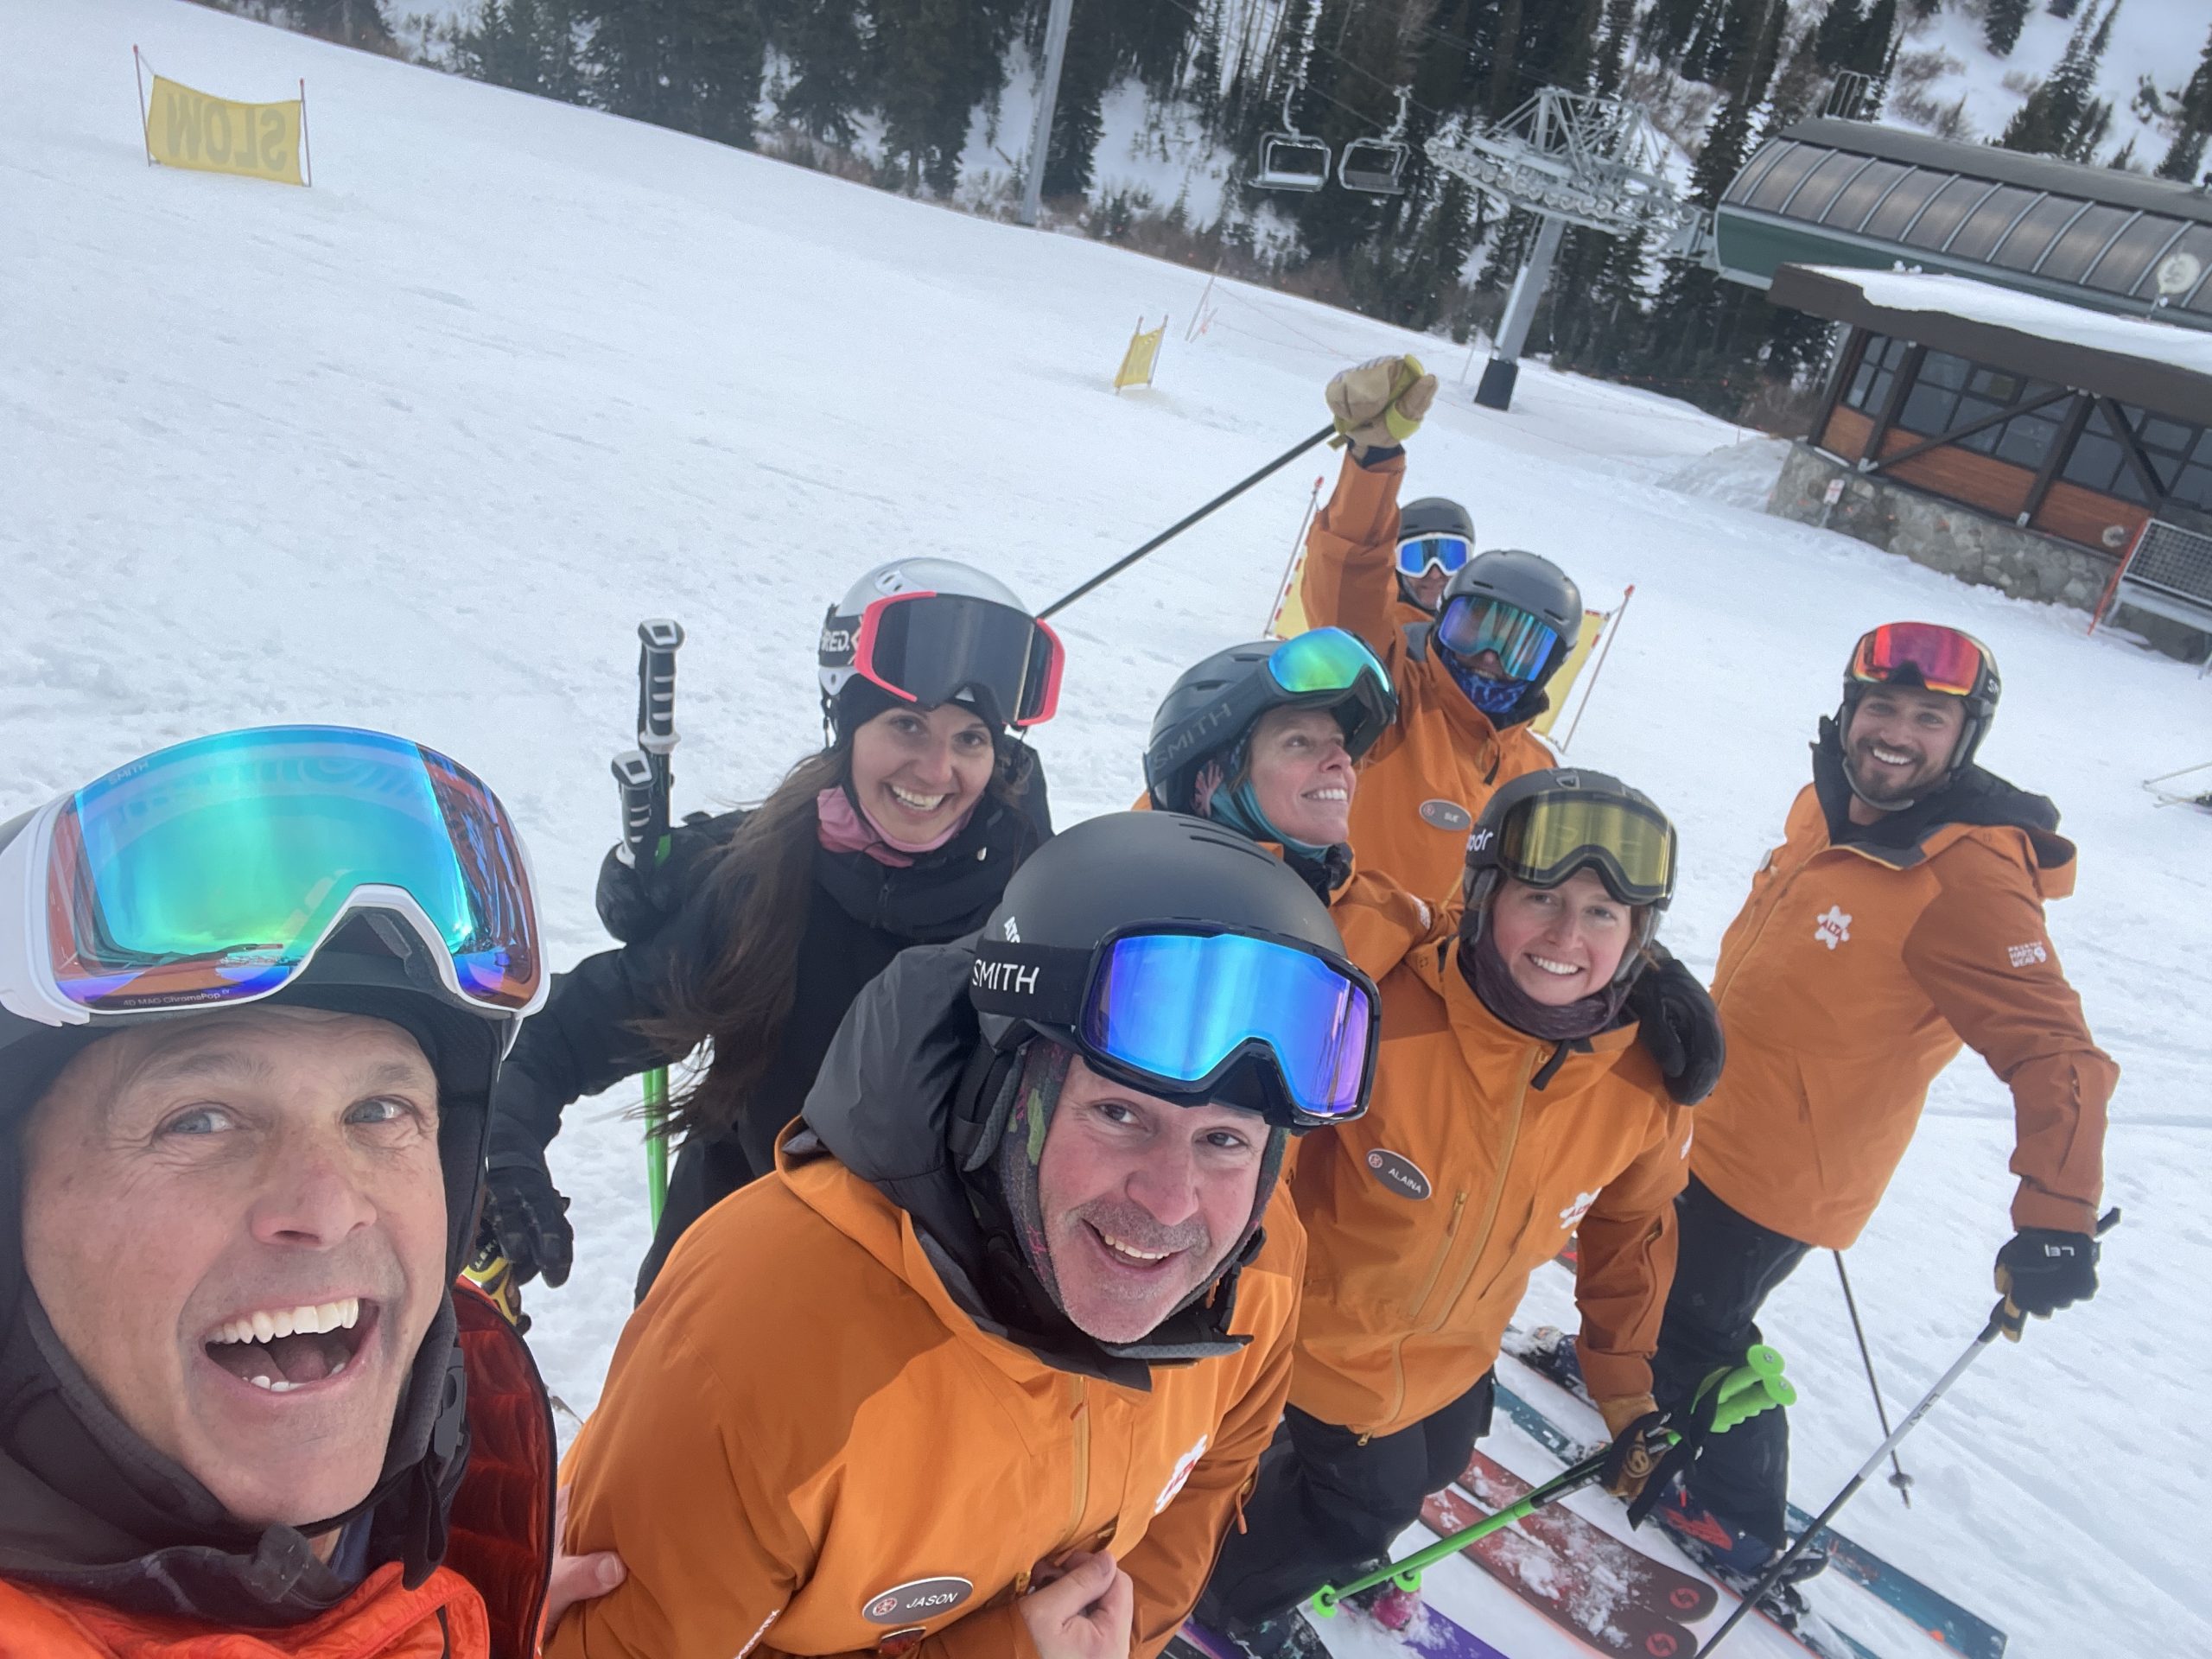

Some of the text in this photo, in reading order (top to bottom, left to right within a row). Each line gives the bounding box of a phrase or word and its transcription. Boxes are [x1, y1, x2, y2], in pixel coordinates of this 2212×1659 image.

[1154, 702, 1232, 771] SMITH
[972, 958, 1039, 995] SMITH
[1388, 1168, 1422, 1194] ALAINA
[906, 1592, 958, 1609] JASON
